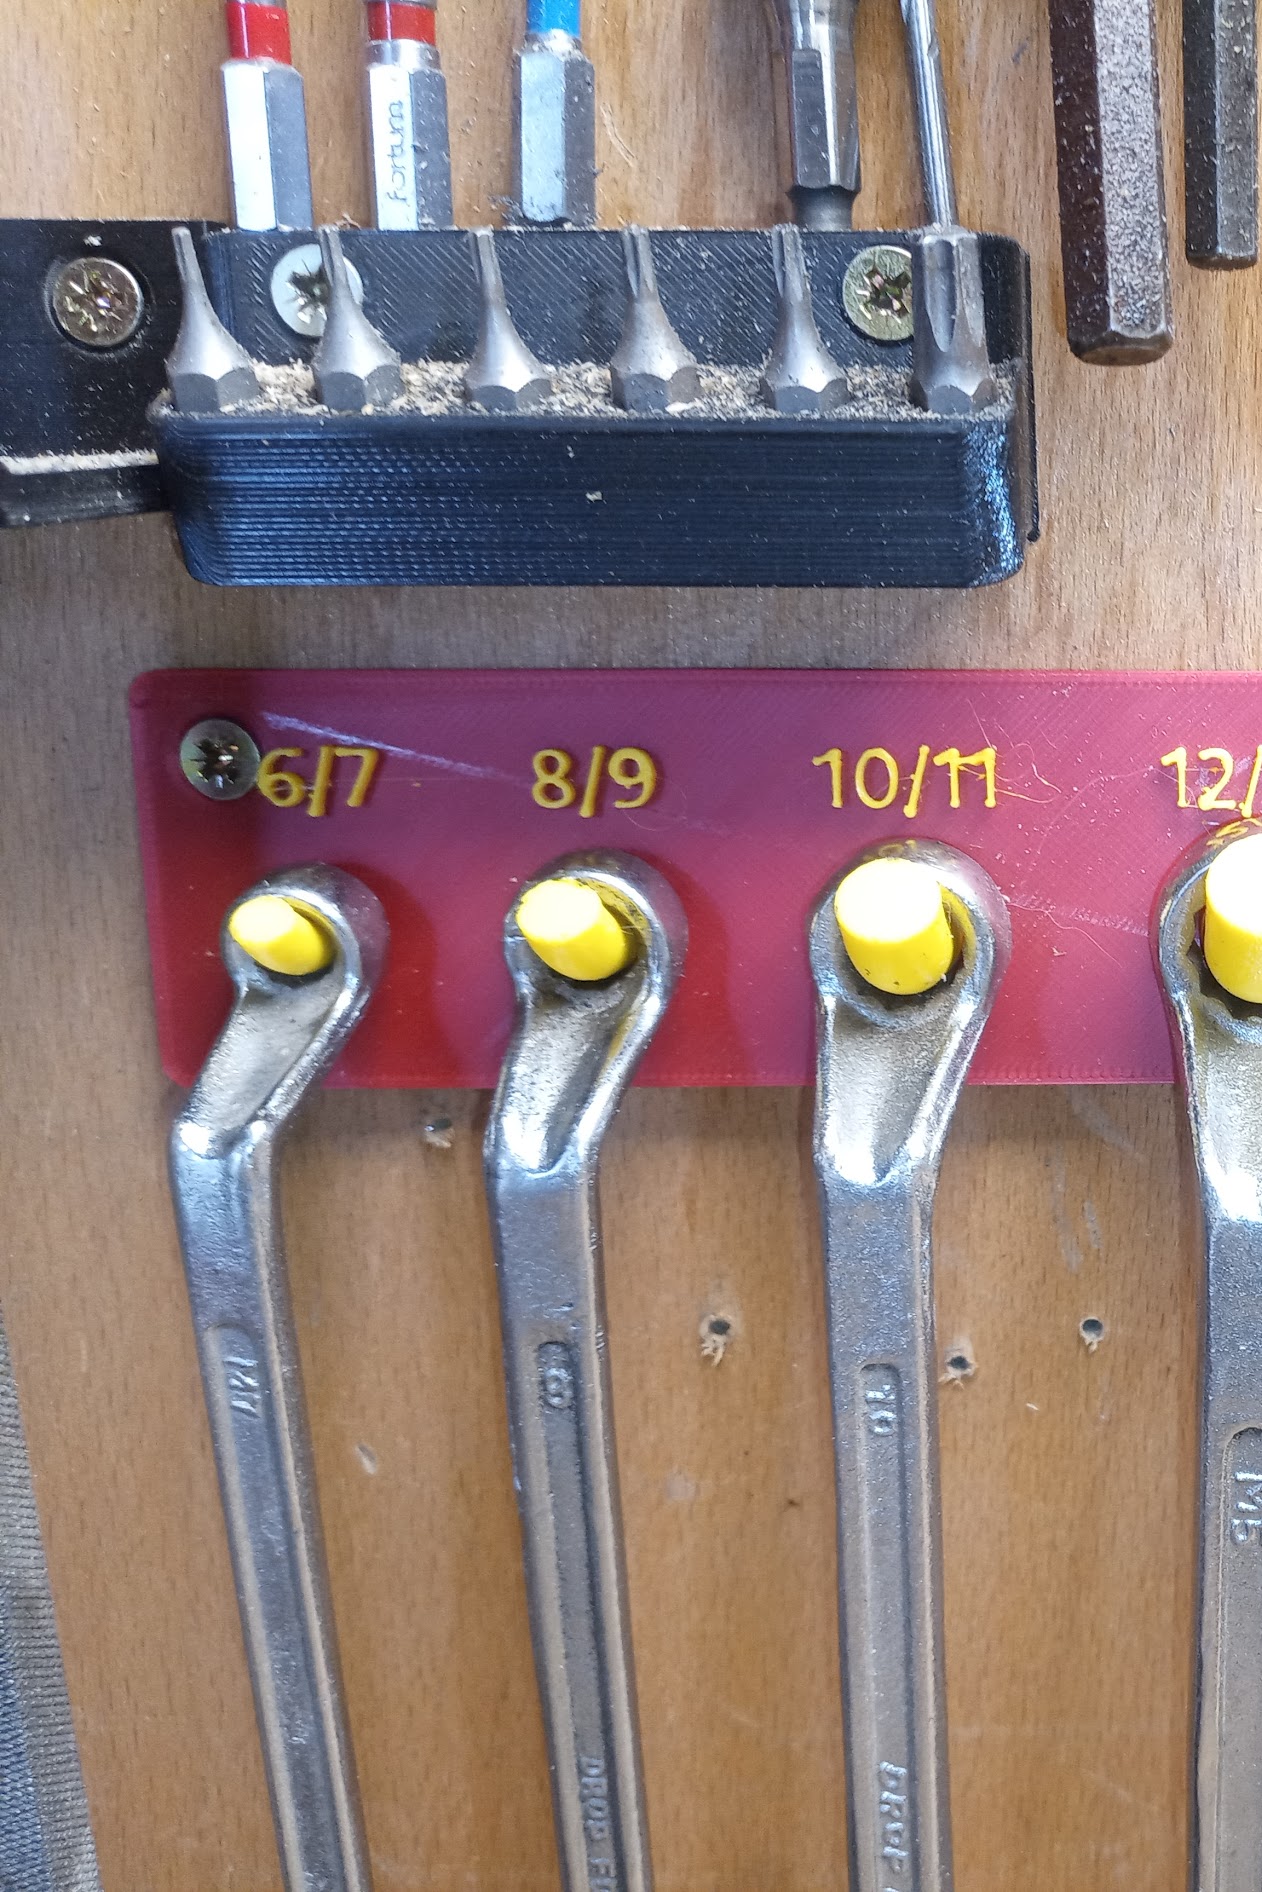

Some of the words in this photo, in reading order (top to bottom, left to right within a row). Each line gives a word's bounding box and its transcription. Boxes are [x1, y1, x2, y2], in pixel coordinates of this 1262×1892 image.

[387, 99, 410, 207] fortum
[257, 746, 377, 817] 6/7
[531, 746, 656, 817] 8/9
[812, 745, 997, 817] 10/11
